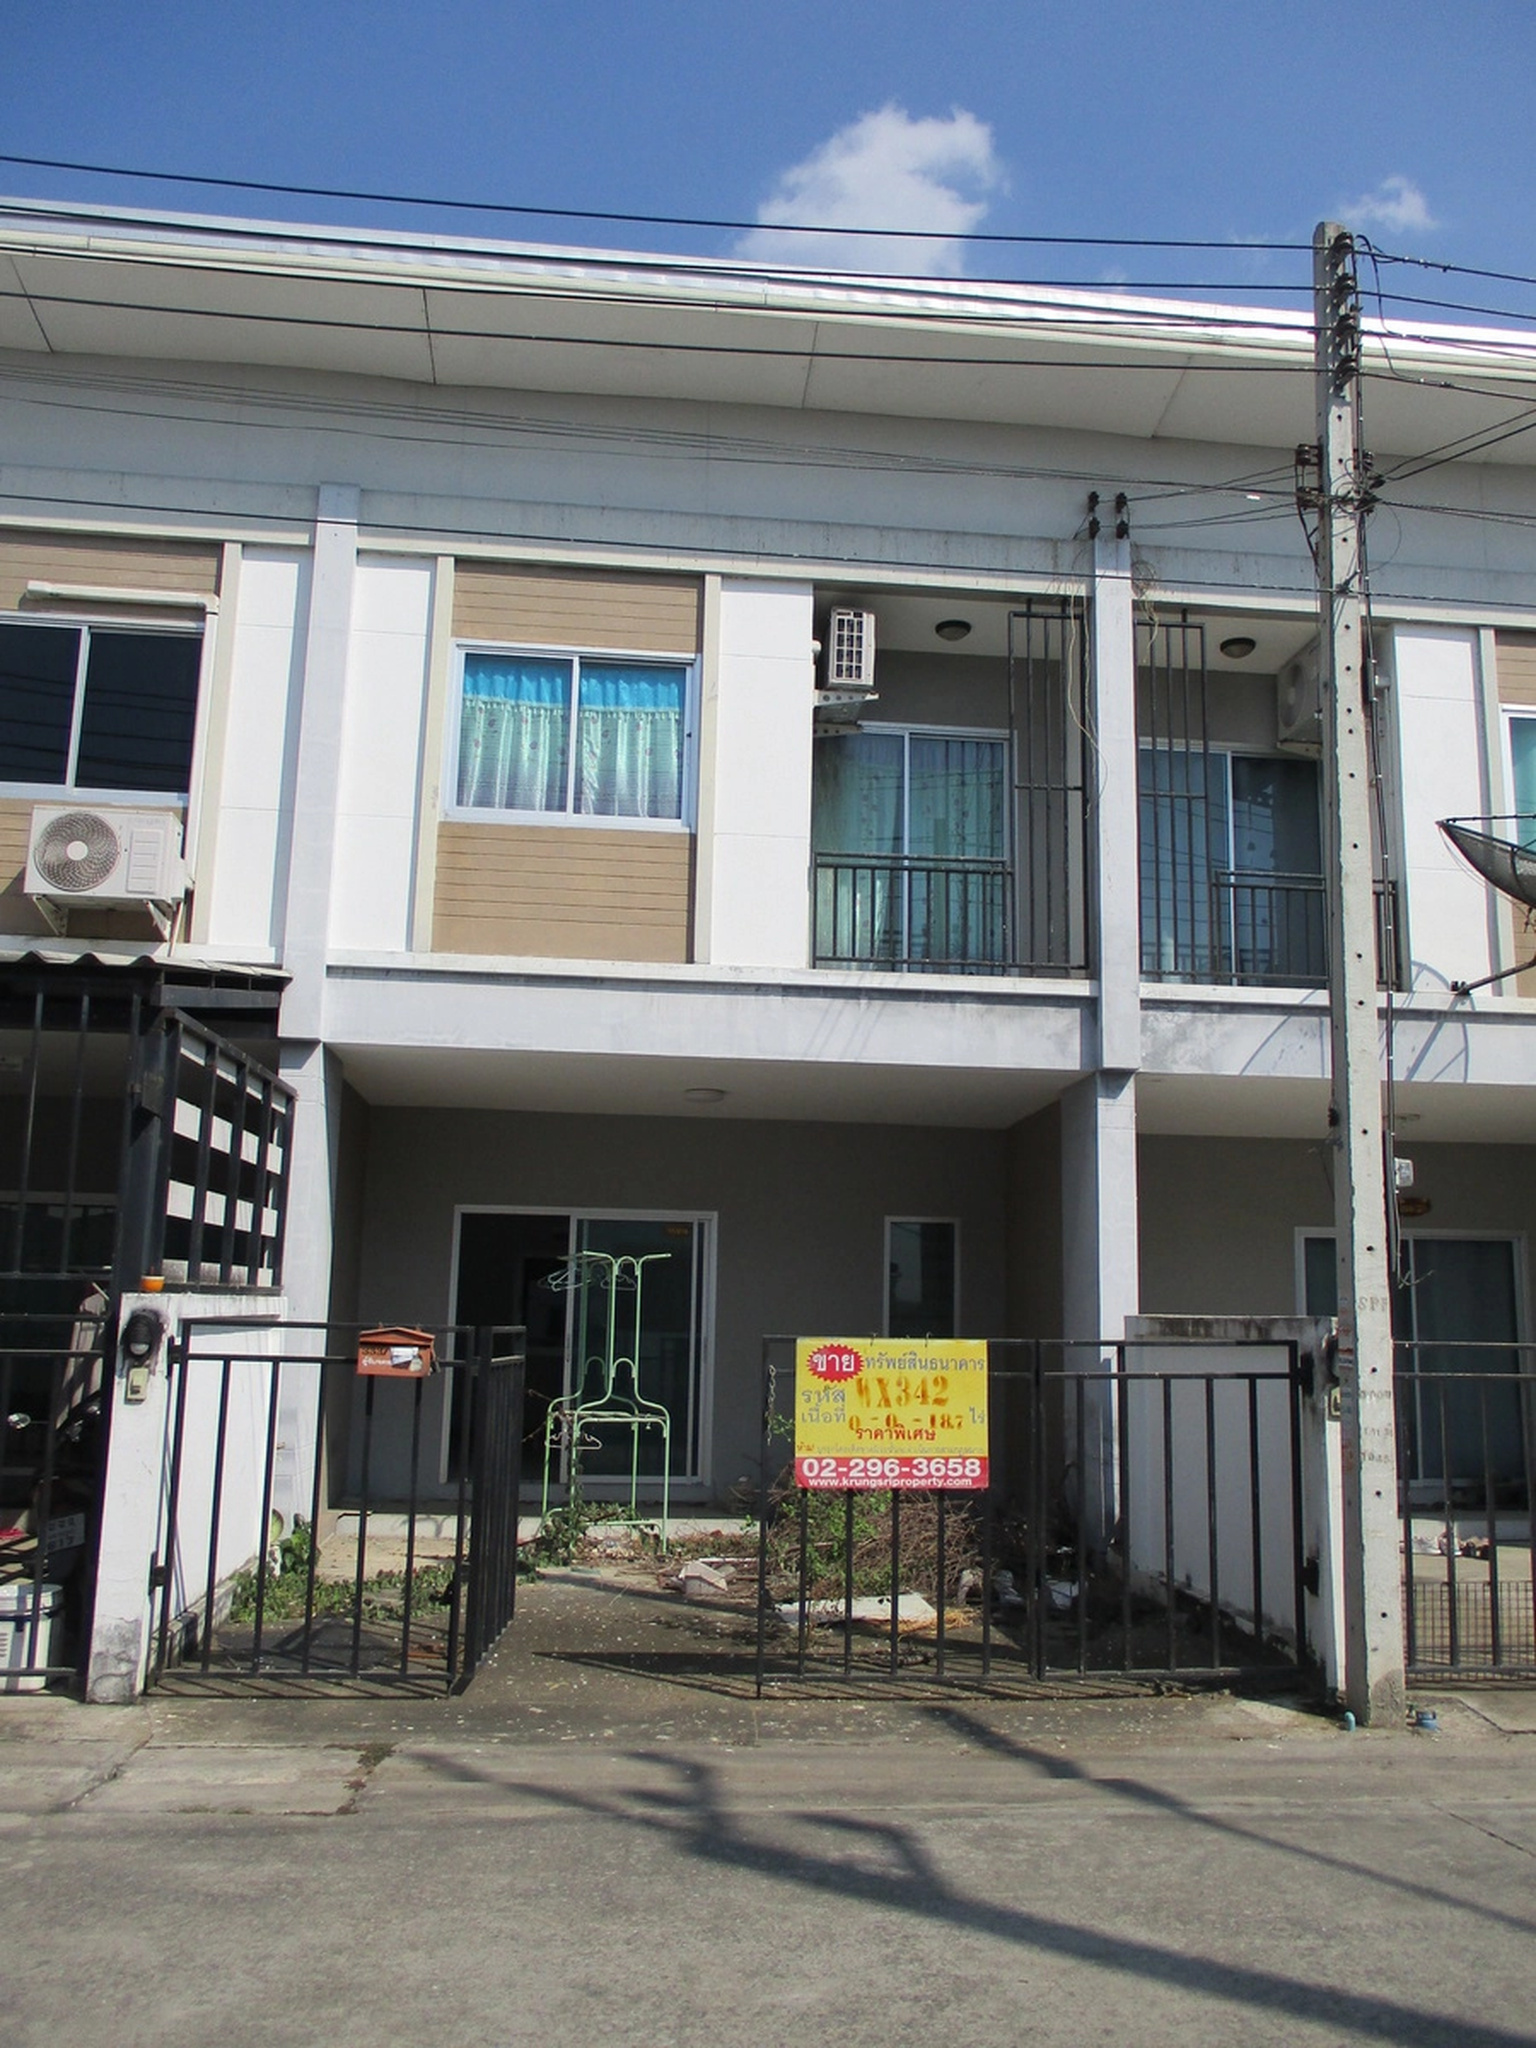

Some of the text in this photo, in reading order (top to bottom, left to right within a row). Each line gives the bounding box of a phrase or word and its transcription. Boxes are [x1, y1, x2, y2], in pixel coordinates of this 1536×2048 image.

[812, 1351, 985, 1372] ขาย ทรัพย์สินธนาคาร
[801, 1385, 846, 1403] รหัส
[856, 1423, 936, 1441] ราคาพิเศษ
[802, 1458, 981, 1477] 02-296-3658
[808, 1477, 972, 1488] www.krungsriproperty.com
